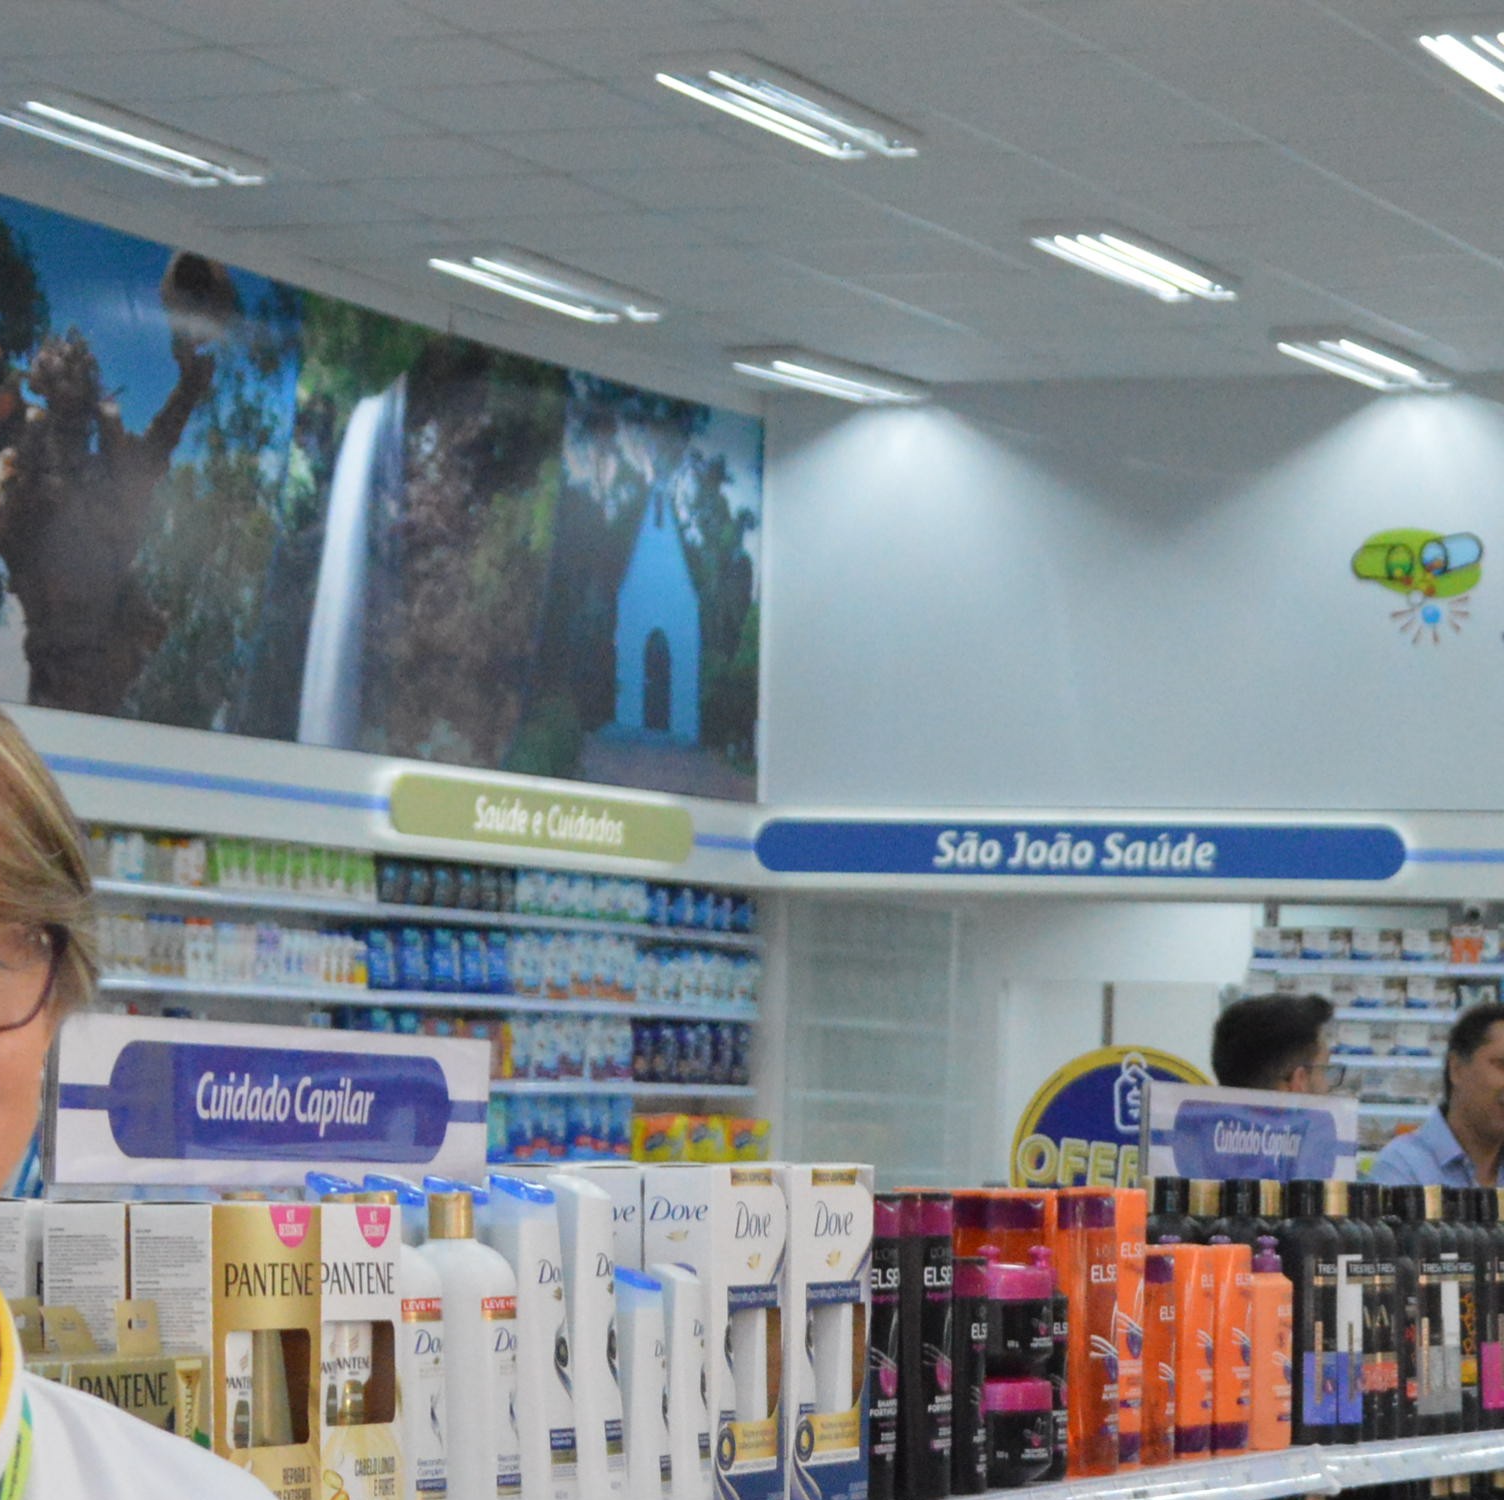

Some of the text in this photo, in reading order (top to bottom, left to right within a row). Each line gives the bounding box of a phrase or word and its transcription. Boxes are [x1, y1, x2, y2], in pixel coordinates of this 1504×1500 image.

[476, 795, 623, 846] Saúde e Cuidados
[935, 830, 1216, 870] São João Saúde
[197, 1073, 374, 1137] Cuidado Capilar
[1215, 1121, 1302, 1162] Cuidado Capilar
[650, 1196, 708, 1221] Dove
[735, 1201, 771, 1239] Dove
[815, 1201, 853, 1237] Dove
[225, 1262, 314, 1297] PANTENE
[321, 1262, 394, 1295] PANTENE
[924, 1266, 952, 1286] ELSE
[414, 1329, 441, 1354] Do
[495, 1328, 517, 1352] Do
[80, 1372, 168, 1408] PANTENE
